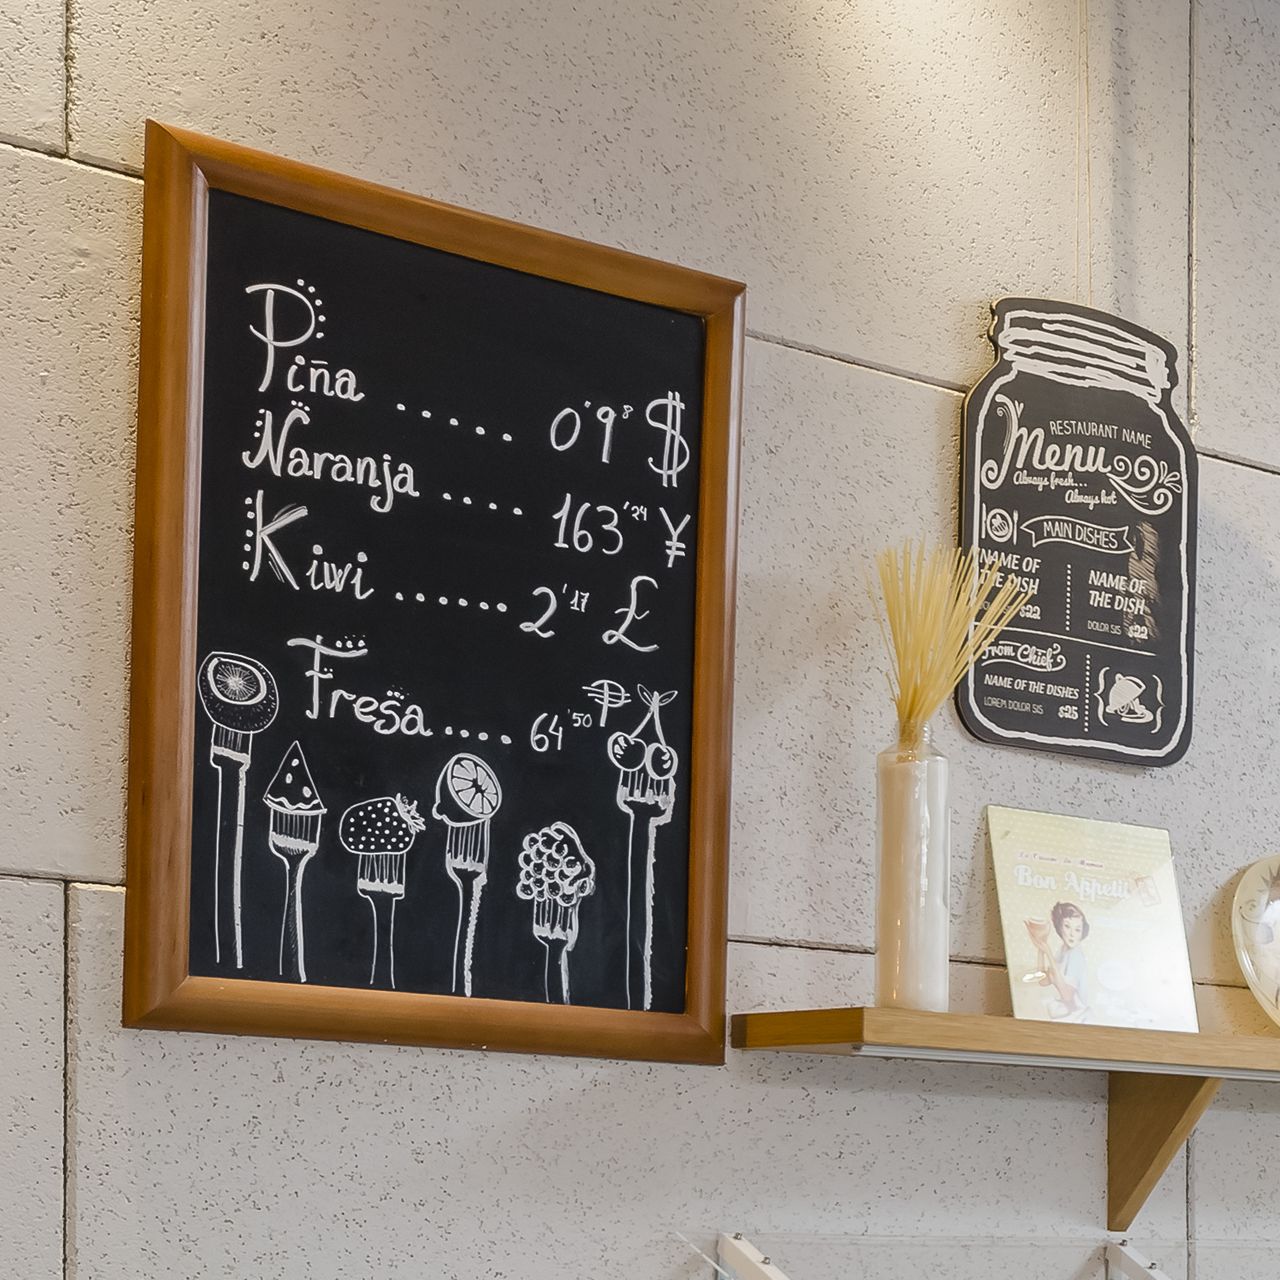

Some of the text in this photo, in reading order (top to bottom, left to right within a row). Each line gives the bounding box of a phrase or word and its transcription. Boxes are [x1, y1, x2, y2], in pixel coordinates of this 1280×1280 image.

[981, 394, 1112, 489] Menu
[1050, 420, 1152, 449] RESTAURANT NAME
[242, 402, 420, 512] Naranja
[1013, 470, 1050, 491] Always
[1065, 489, 1118, 510] Always hot
[244, 490, 374, 599] Kiwi
[1043, 521, 1119, 549] MAIN DISHES
[980, 549, 1041, 574] NAME OF
[1088, 570, 1148, 594] NAME OF
[1088, 590, 1146, 615] THE DISH
[983, 674, 1080, 700] NAME OF THE DISHES
[1014, 864, 1130, 902] Bon Appetit
